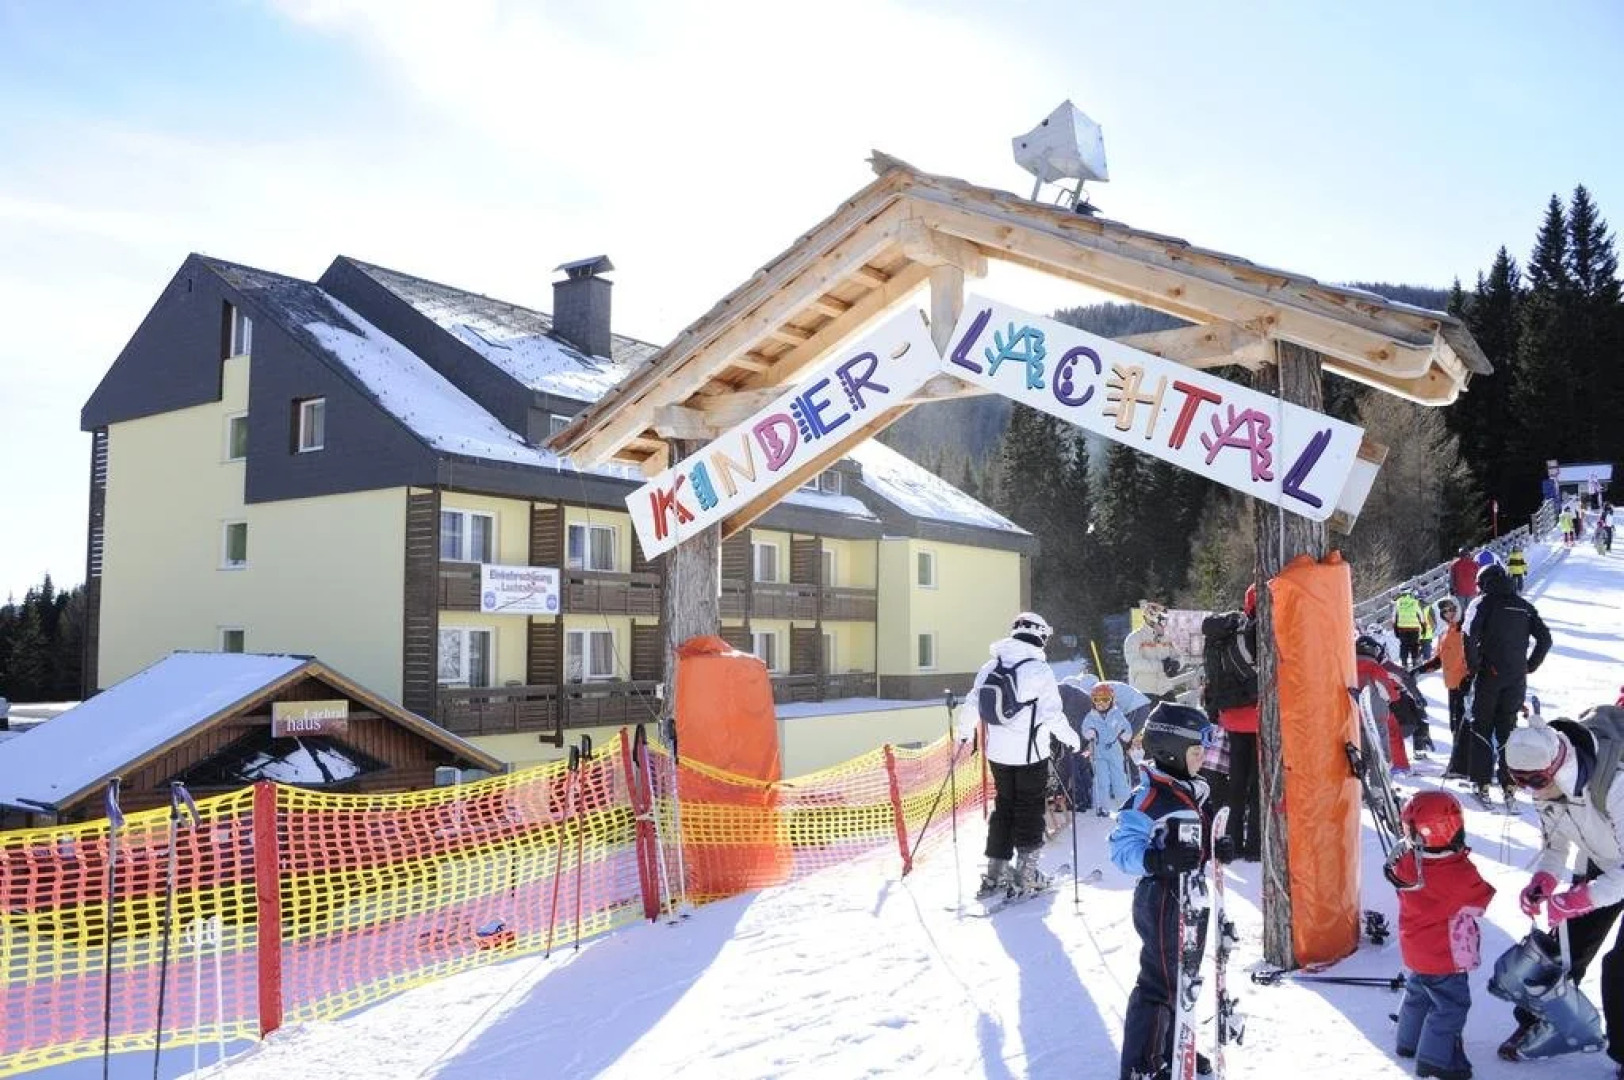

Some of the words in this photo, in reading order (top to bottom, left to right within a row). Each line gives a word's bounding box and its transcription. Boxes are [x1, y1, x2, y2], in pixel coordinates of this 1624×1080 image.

[649, 341, 912, 541] KINDER-
[950, 307, 1332, 509] LACHTAL
[286, 714, 321, 732] haus
